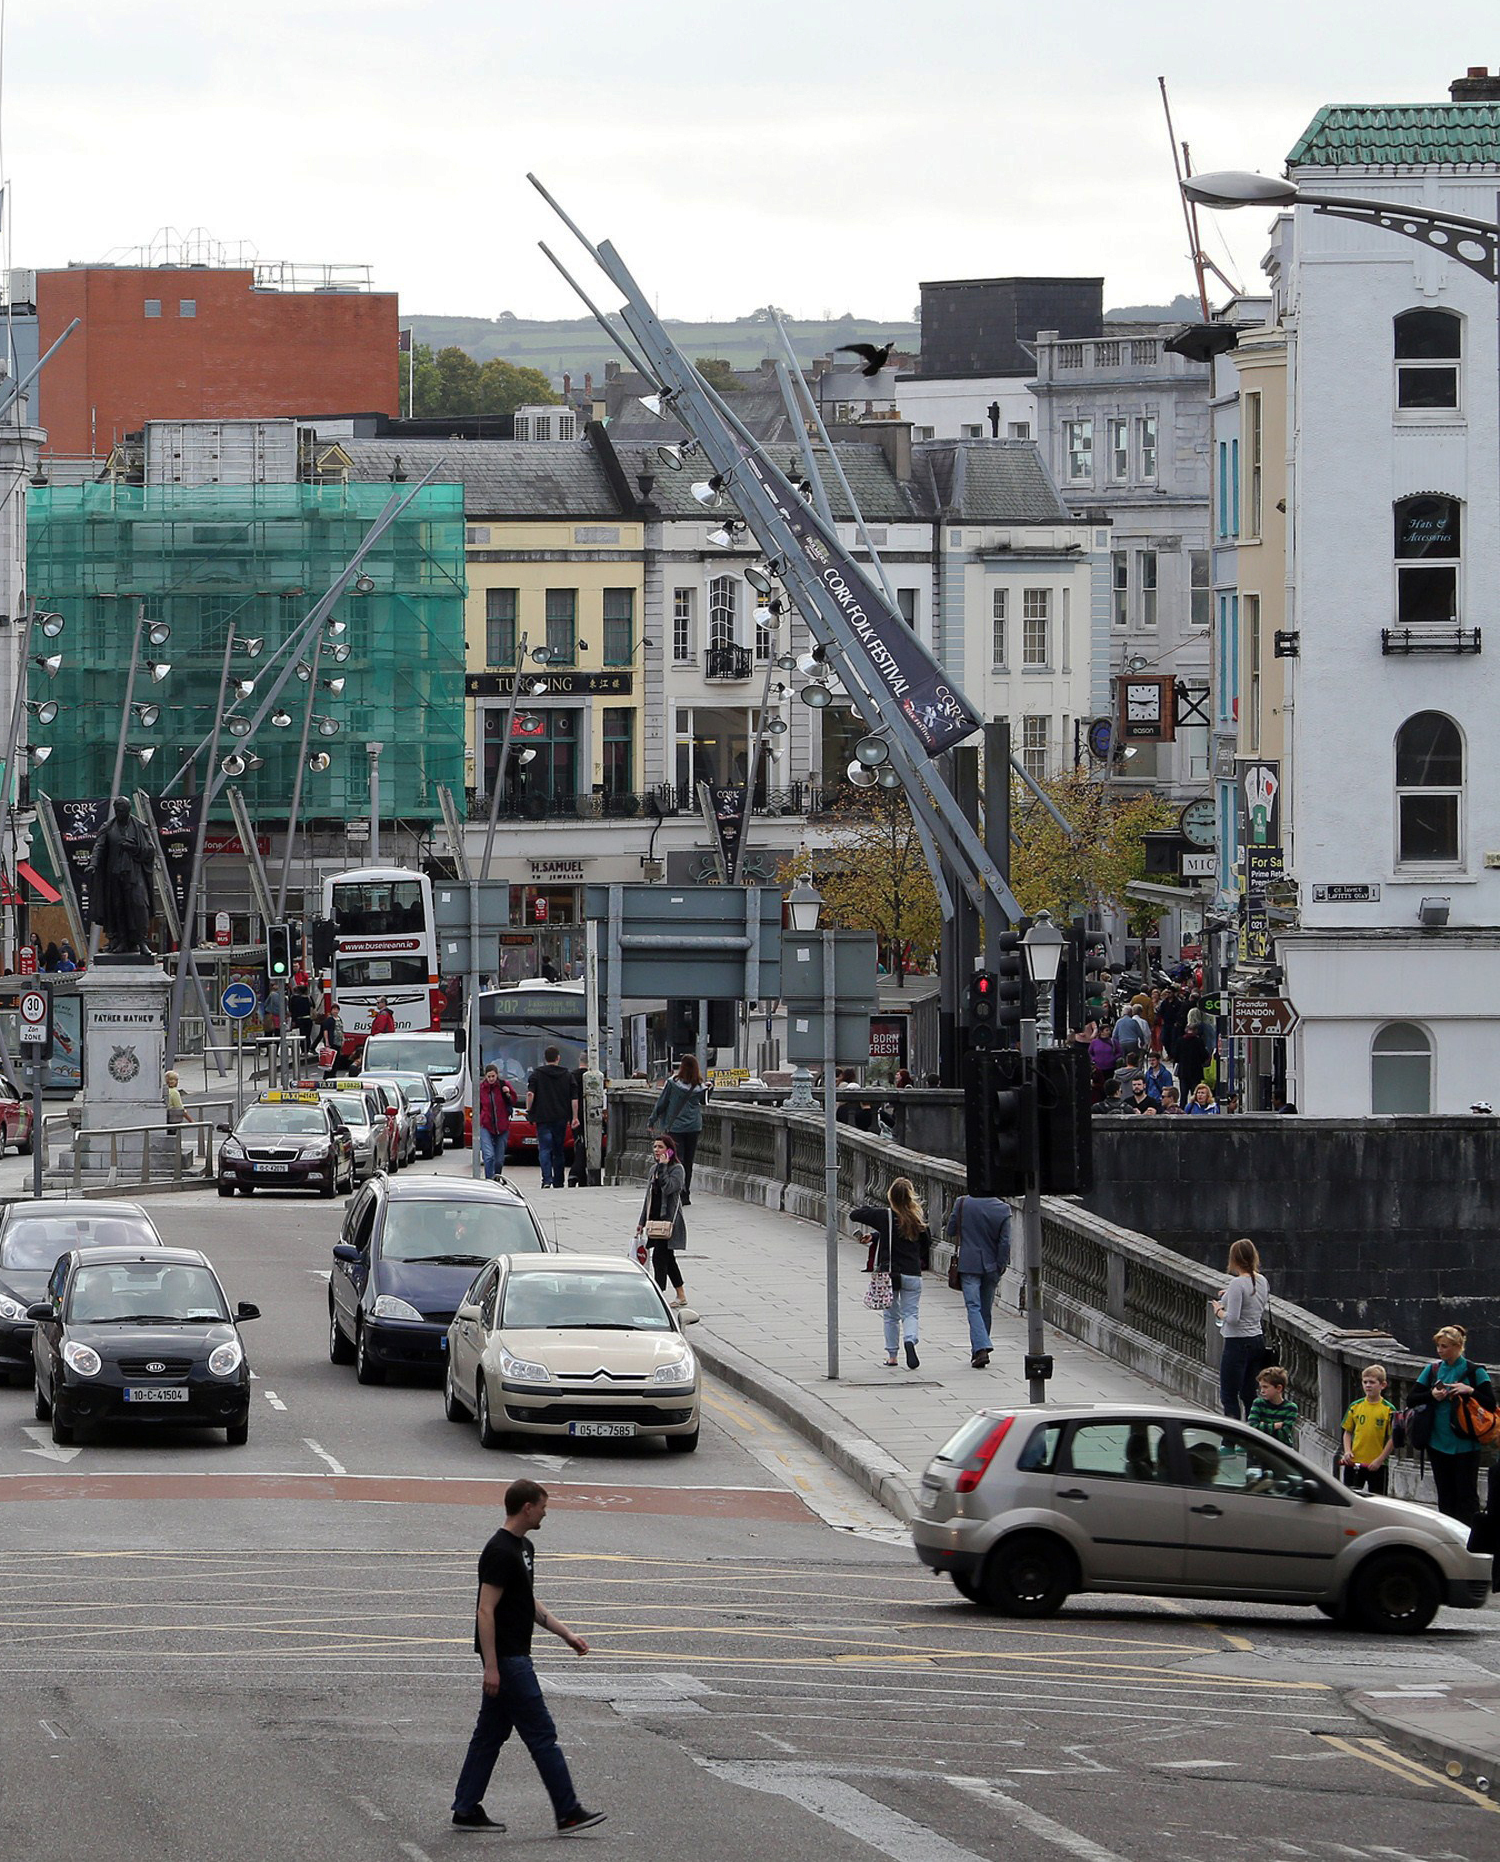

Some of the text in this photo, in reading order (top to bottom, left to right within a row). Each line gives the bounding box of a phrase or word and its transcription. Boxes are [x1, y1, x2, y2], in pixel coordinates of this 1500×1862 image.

[1409, 518, 1433, 529] Hats
[1403, 532, 1452, 543] Accessories
[823, 569, 910, 698] CORK FOLK FESTIVAL
[935, 685, 968, 728] CORK
[1132, 727, 1154, 735] eason
[717, 791, 739, 799] CORK
[63, 803, 98, 814] CORK
[160, 799, 192, 811] CORK
[531, 861, 584, 873] H.SAMUEL
[1187, 860, 1214, 870] MIC
[1251, 857, 1268, 868] For
[1251, 870, 1269, 878] Prime
[1251, 921, 1263, 929] 021
[345, 941, 414, 951] www.buseireann.ie
[27, 998, 39, 1011] 30
[496, 1000, 519, 1014] 207
[1235, 1008, 1275, 1016] SHANDON
[94, 1013, 154, 1023] FATHER MATHEW
[354, 1022, 372, 1031] Bus
[873, 1033, 899, 1044] BORN
[869, 1043, 899, 1054] FRESH
[134, 1390, 183, 1401] 10-C-41504
[580, 1424, 631, 1437] 05-C-7585
